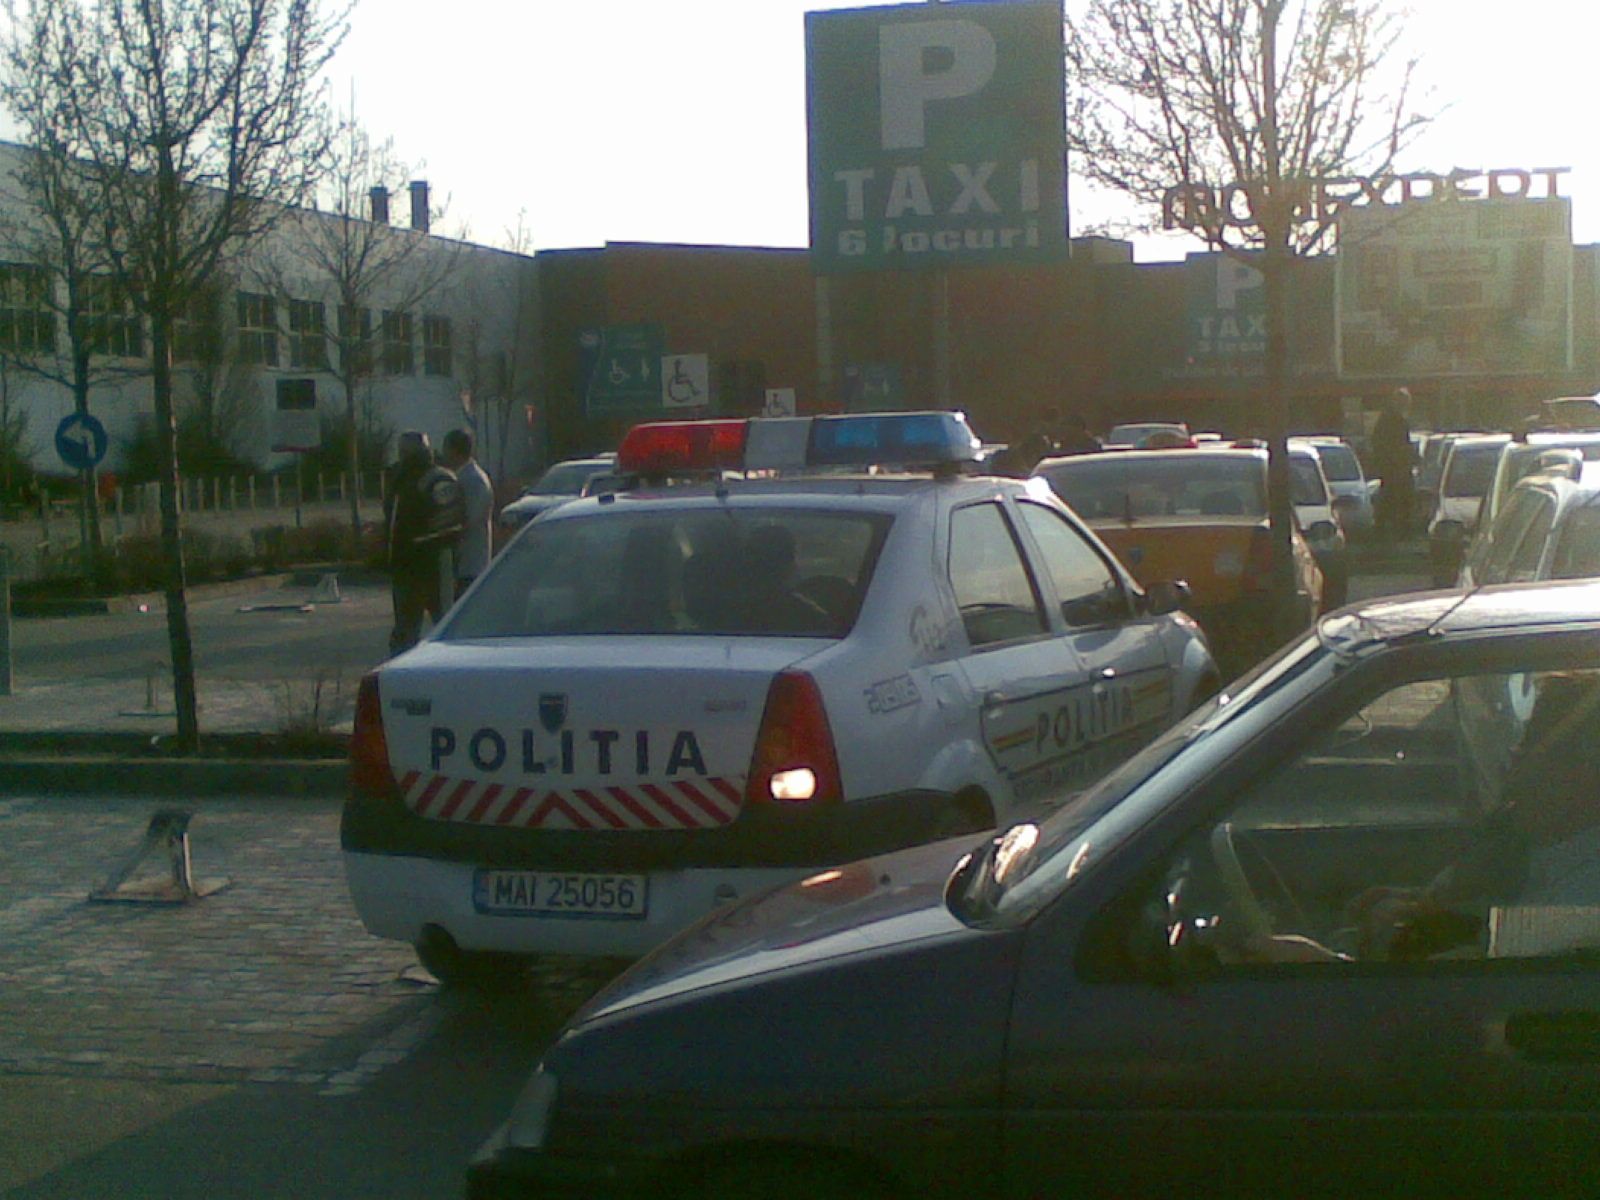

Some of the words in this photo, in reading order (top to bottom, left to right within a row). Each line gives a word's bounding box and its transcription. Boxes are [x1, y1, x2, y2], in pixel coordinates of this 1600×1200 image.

[879, 19, 997, 150] P
[834, 160, 1040, 220] TAXI
[837, 229, 867, 255] 6
[883, 219, 1039, 254] locuri
[1217, 258, 1266, 309] P
[1199, 314, 1268, 339] TAX
[1035, 686, 1134, 753] POLITIA
[430, 727, 708, 776] POLITIA
[494, 876, 537, 907] MAI
[546, 878, 636, 910] 25056
